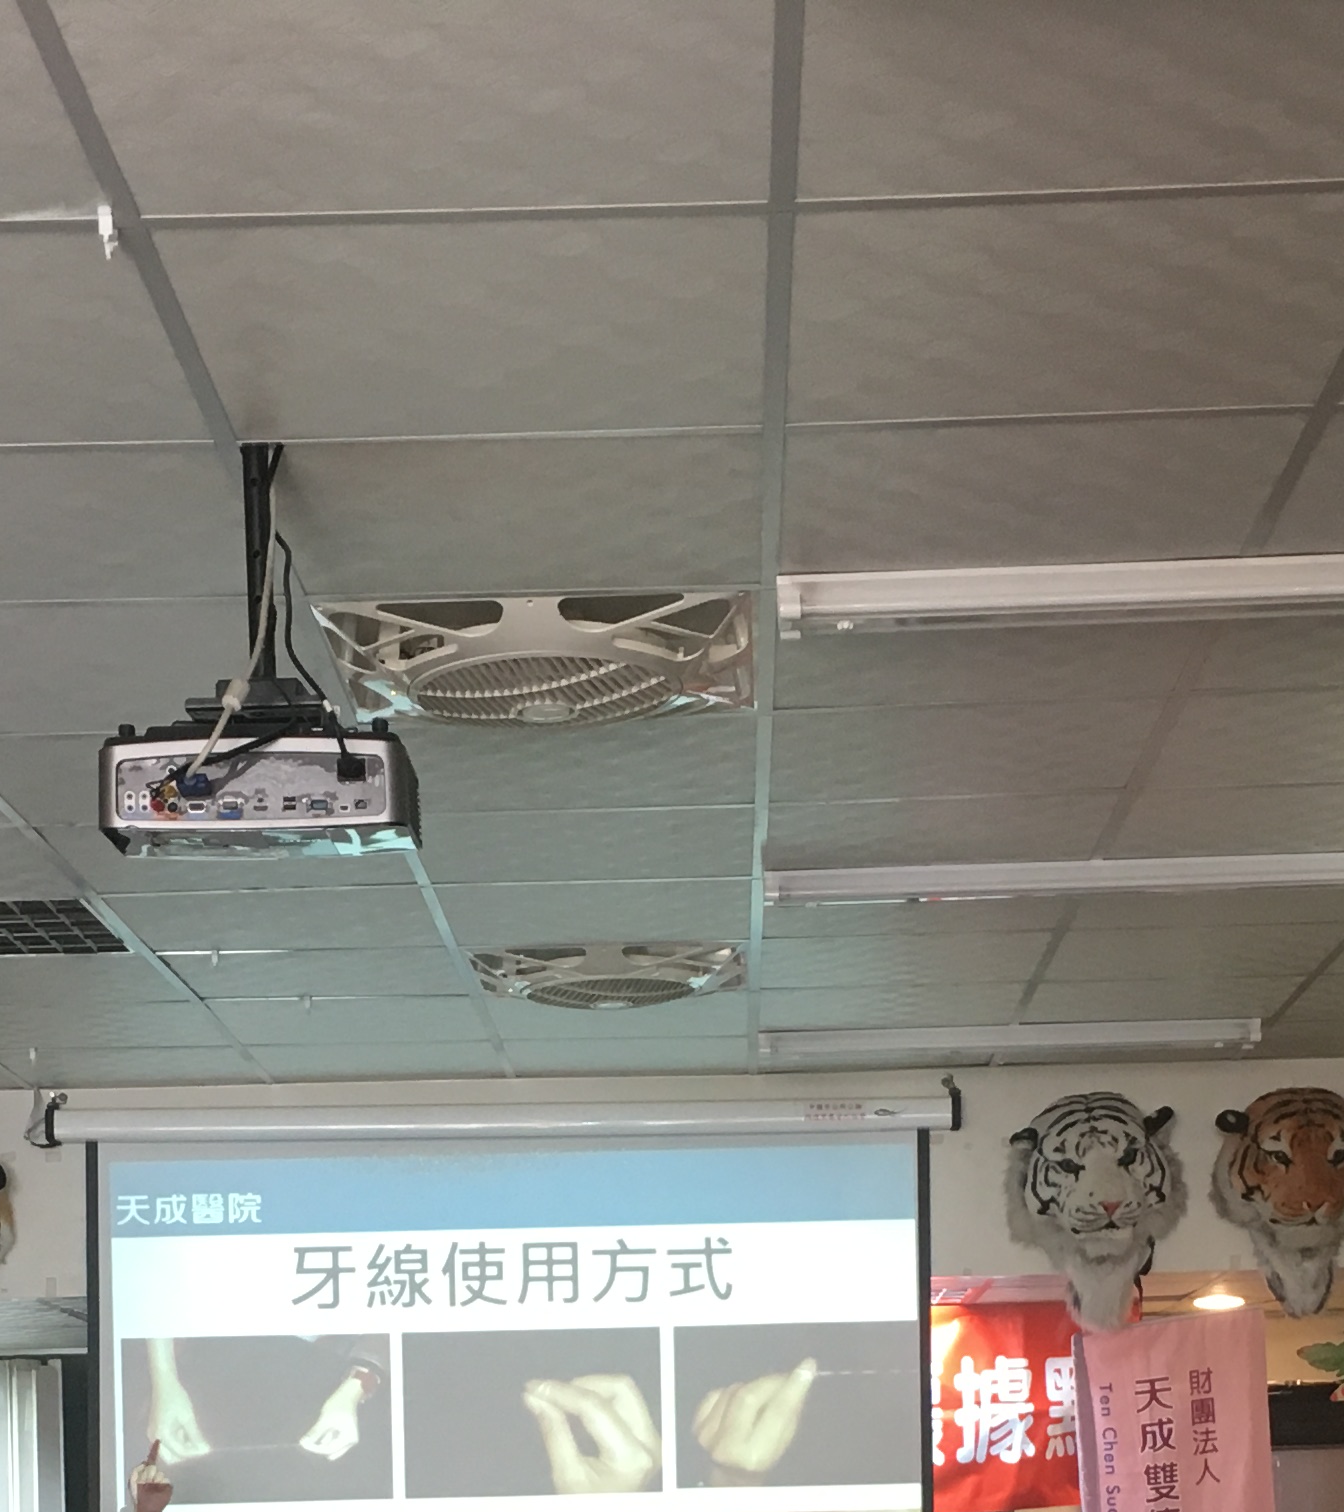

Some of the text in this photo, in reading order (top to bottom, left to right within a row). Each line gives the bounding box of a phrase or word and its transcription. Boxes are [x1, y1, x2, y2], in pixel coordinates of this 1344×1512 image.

[116, 1192, 262, 1225] 天成醫院
[291, 1236, 734, 1309] 牙線使用方式
[1098, 1382, 1114, 1417] Ten
[1102, 1426, 1118, 1475] Chen
[1189, 1367, 1221, 1486] 財團法人
